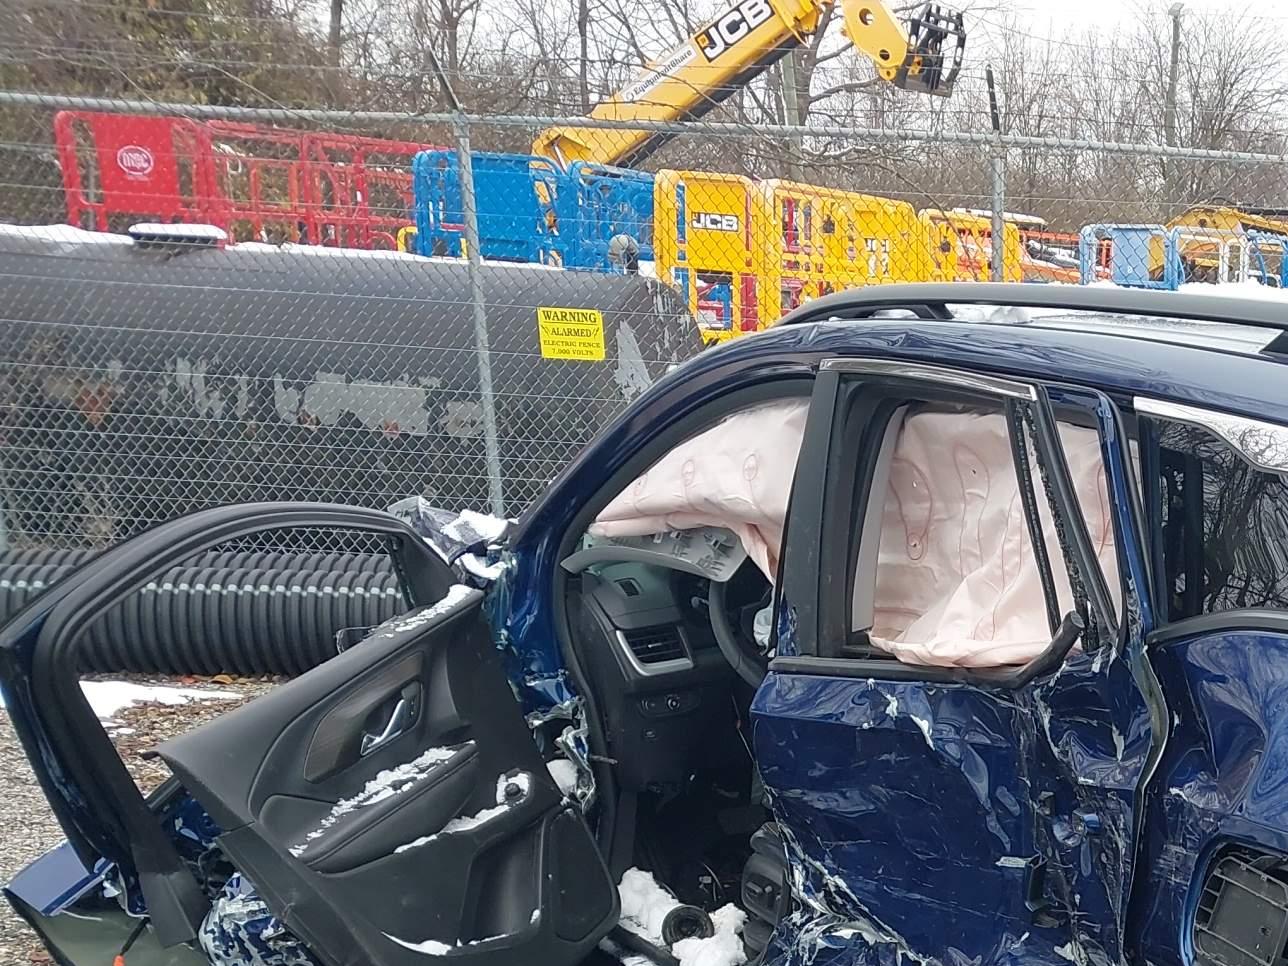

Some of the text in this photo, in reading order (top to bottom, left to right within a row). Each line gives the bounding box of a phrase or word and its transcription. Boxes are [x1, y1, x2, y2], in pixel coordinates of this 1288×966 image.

[704, 0, 772, 59] JCB
[692, 213, 739, 232] JCB
[542, 310, 597, 323] WARNING
[551, 327, 592, 337] ALARMED
[543, 340, 601, 349] ELECTRIC FENCE
